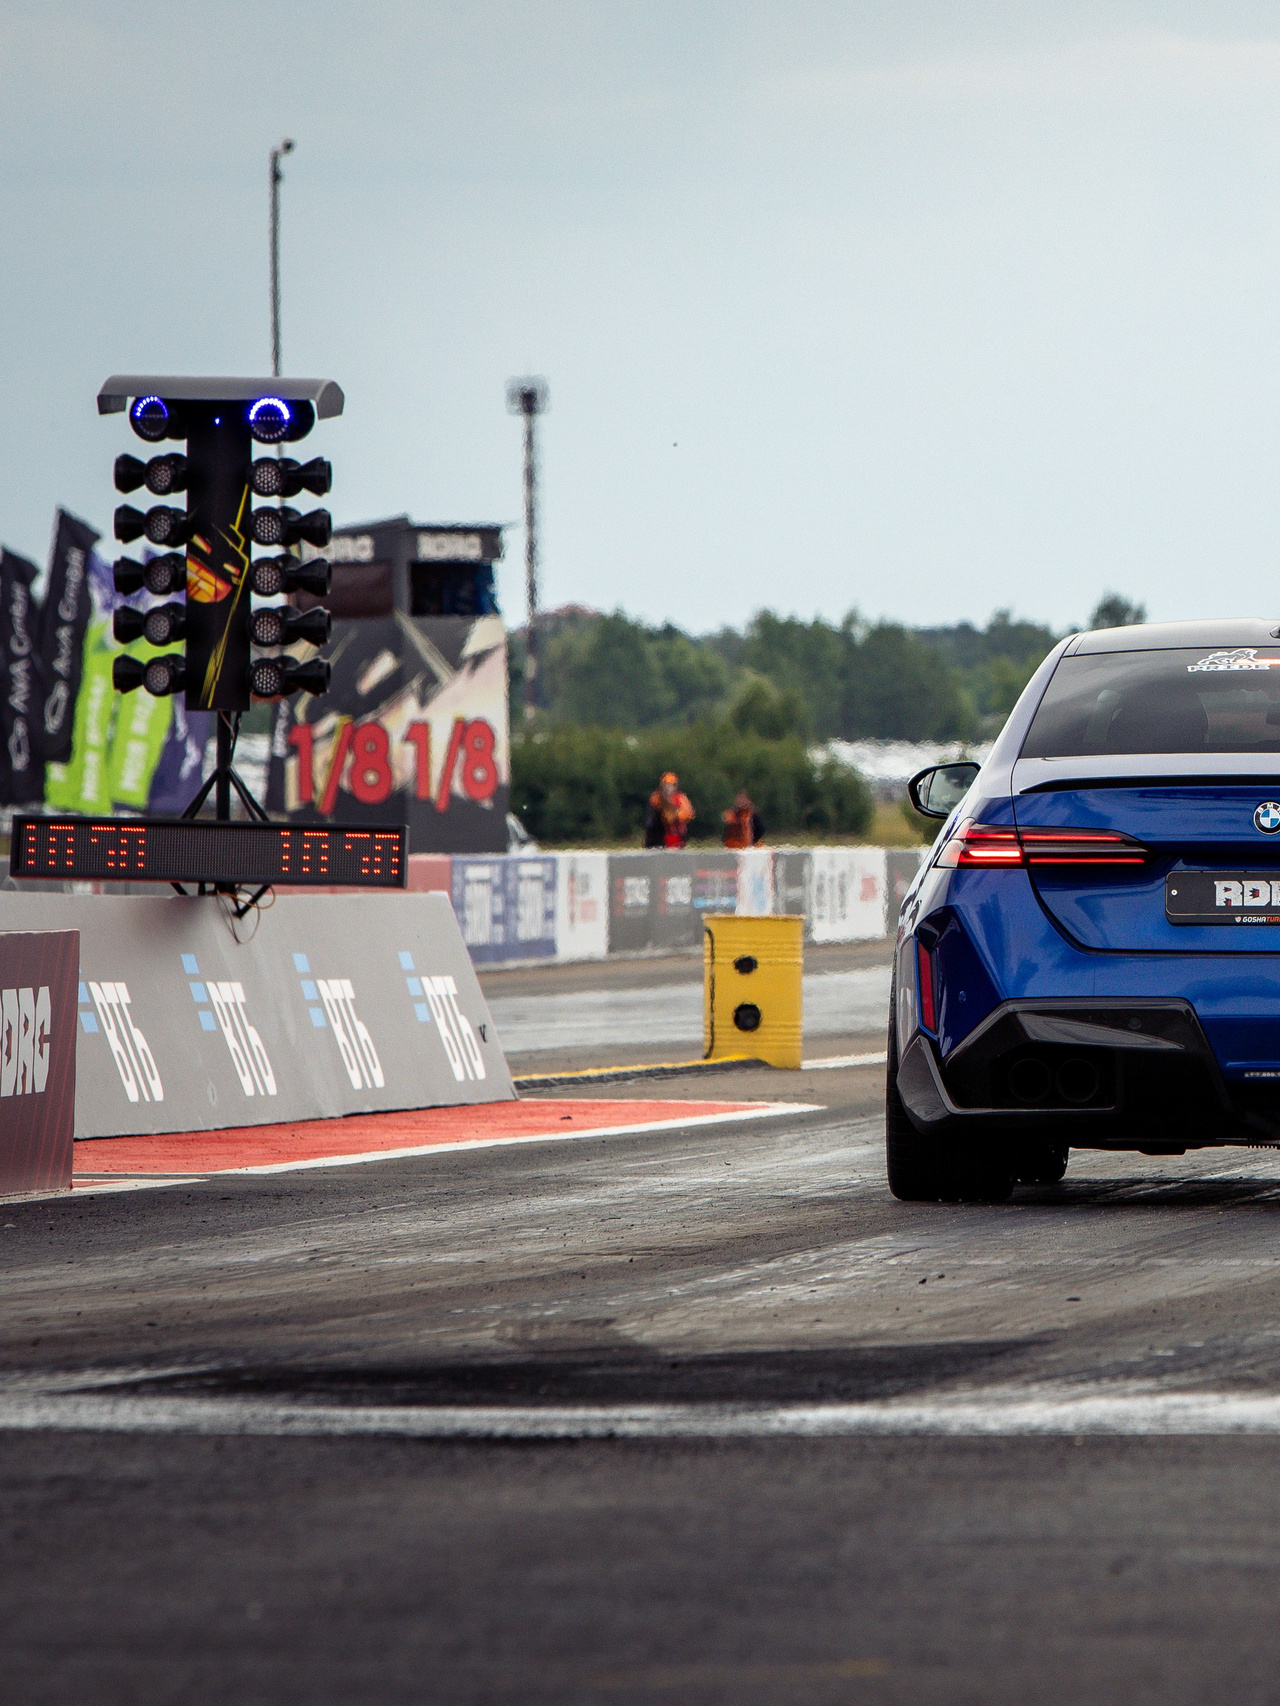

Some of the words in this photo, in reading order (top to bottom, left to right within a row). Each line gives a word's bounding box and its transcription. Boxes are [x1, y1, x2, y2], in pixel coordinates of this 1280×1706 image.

[1187, 663, 1270, 673] PRIDE
[288, 716, 393, 816] 1/8
[405, 715, 498, 814] 1/8
[0, 986, 51, 1098] DRC
